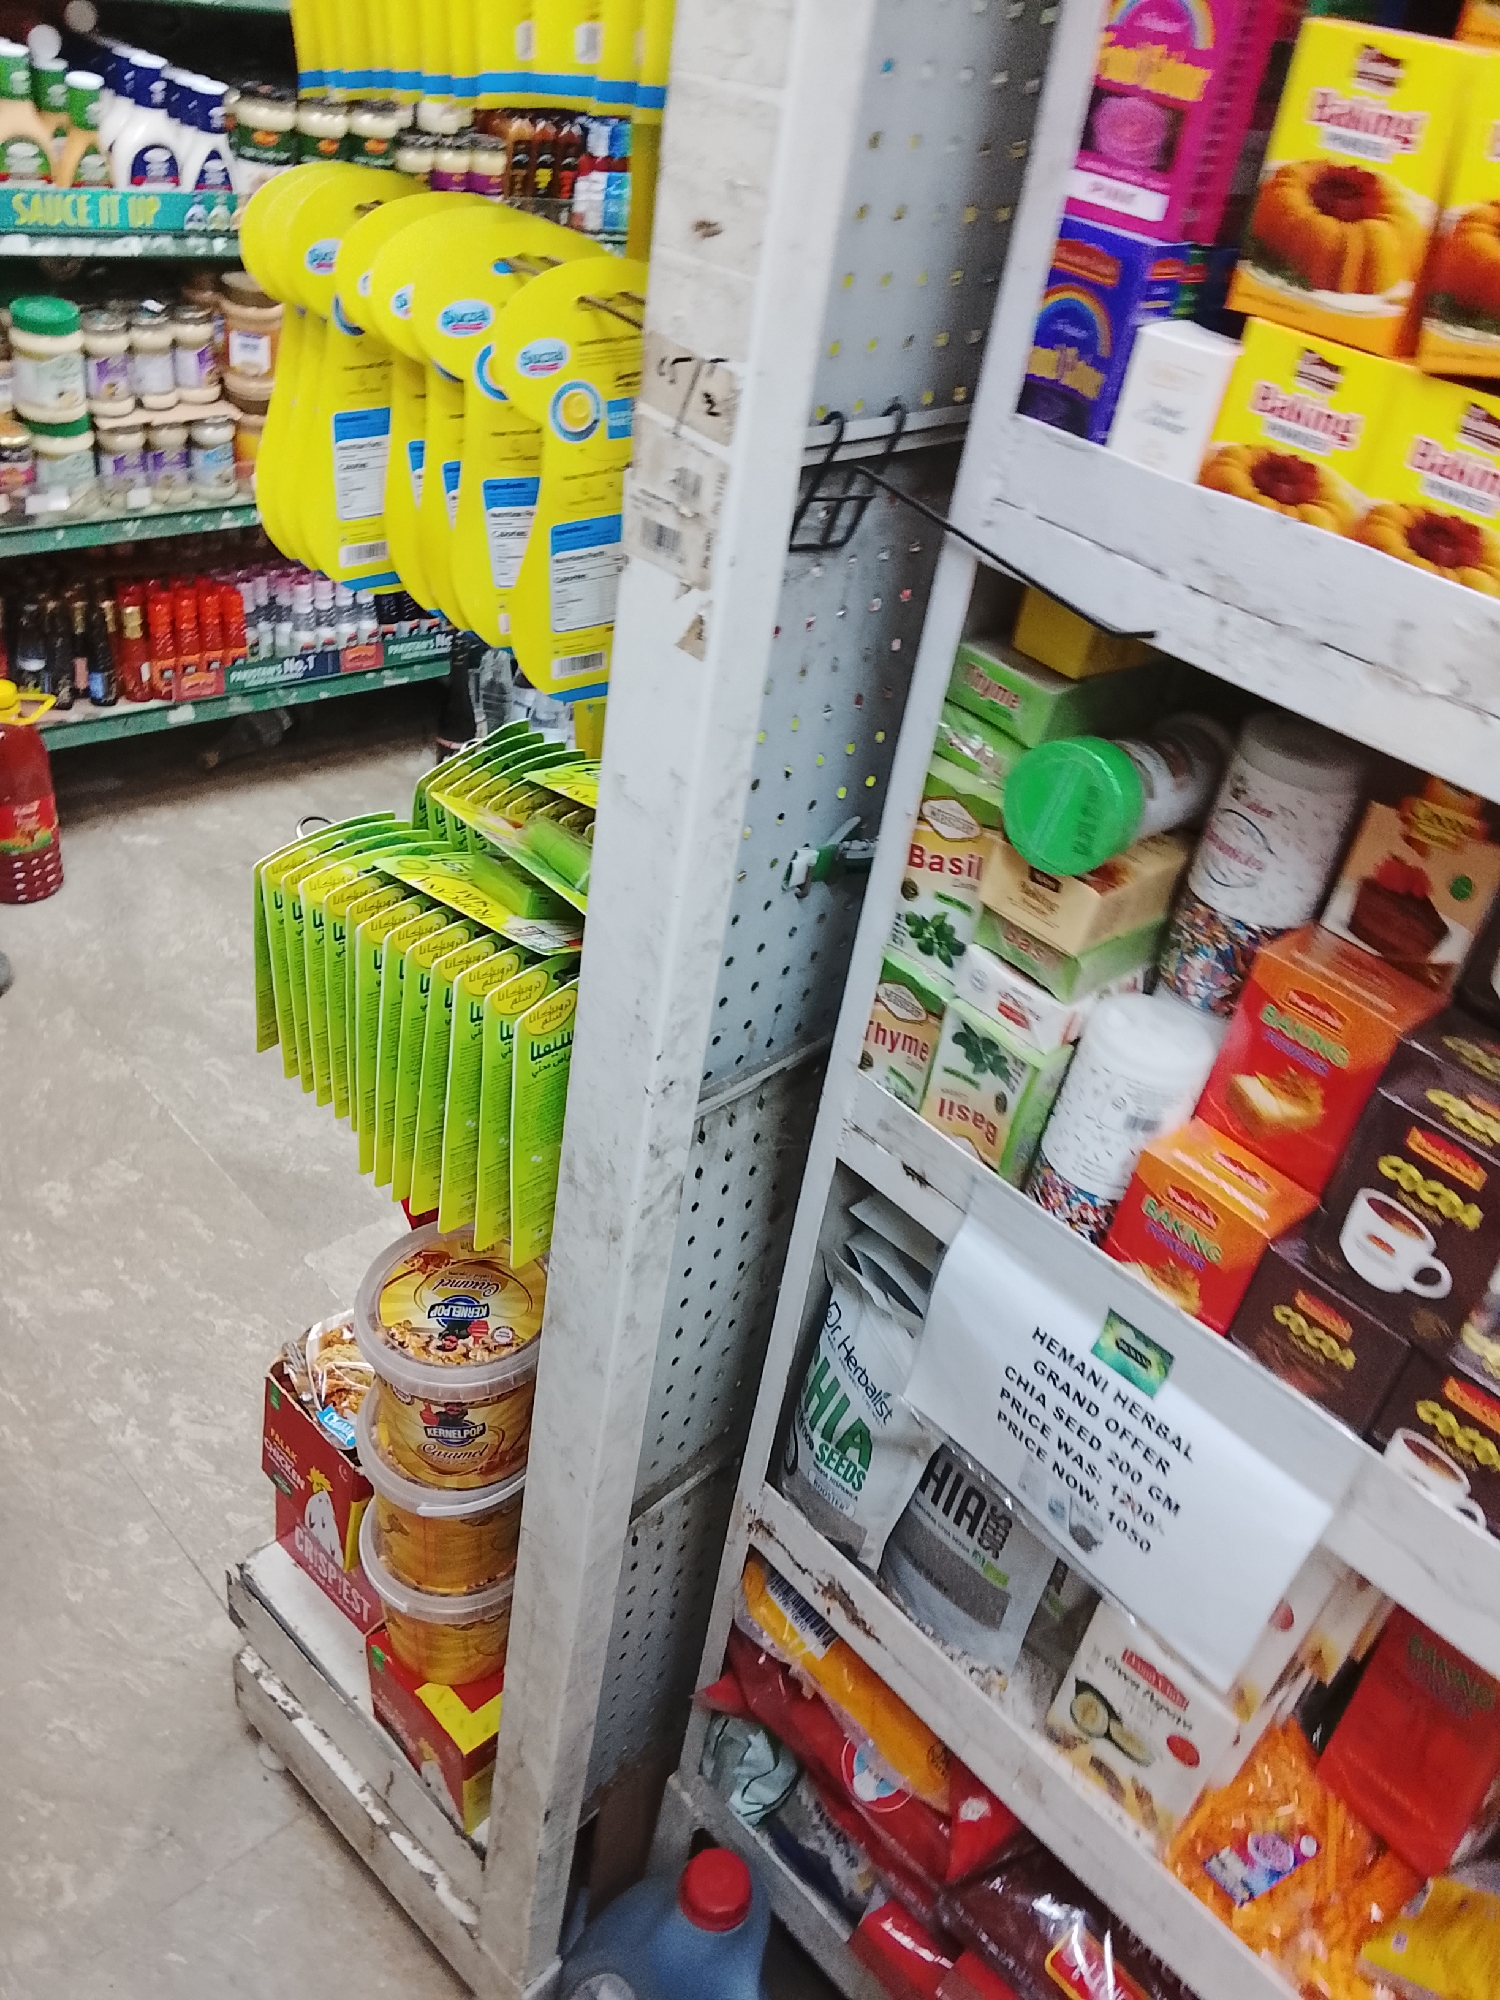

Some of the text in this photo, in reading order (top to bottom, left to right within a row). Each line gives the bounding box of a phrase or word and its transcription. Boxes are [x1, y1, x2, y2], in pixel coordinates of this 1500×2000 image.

[12, 193, 161, 228] SAUCE IT UP
[910, 843, 983, 881] Basil
[1262, 1003, 1349, 1068] BAKING
[938, 1097, 998, 1147] Basil
[1142, 1195, 1222, 1265] BAKING
[429, 1304, 489, 1318] KERNELPOP
[432, 1278, 501, 1297] Caramel
[838, 1335, 893, 1426] Herbalist
[1032, 1326, 1109, 1393] HEMANI
[1112, 1389, 1194, 1462] HERBAL
[427, 1424, 484, 1438] KERNELPOP
[999, 1387, 1052, 1440] PRICE
[1057, 1437, 1102, 1484] WAS:
[1004, 1365, 1181, 1517] CHIA SEED 200 GM
[1033, 1359, 1171, 1477] GRAND OFFER
[264, 1437, 306, 1491] CHICKEN
[422, 1443, 489, 1460] Caramel
[818, 1441, 867, 1492] SEEDS
[997, 1410, 1048, 1464] PRICE
[1051, 1460, 1100, 1511] NOW:
[294, 1523, 372, 1624] CRISPIEST
